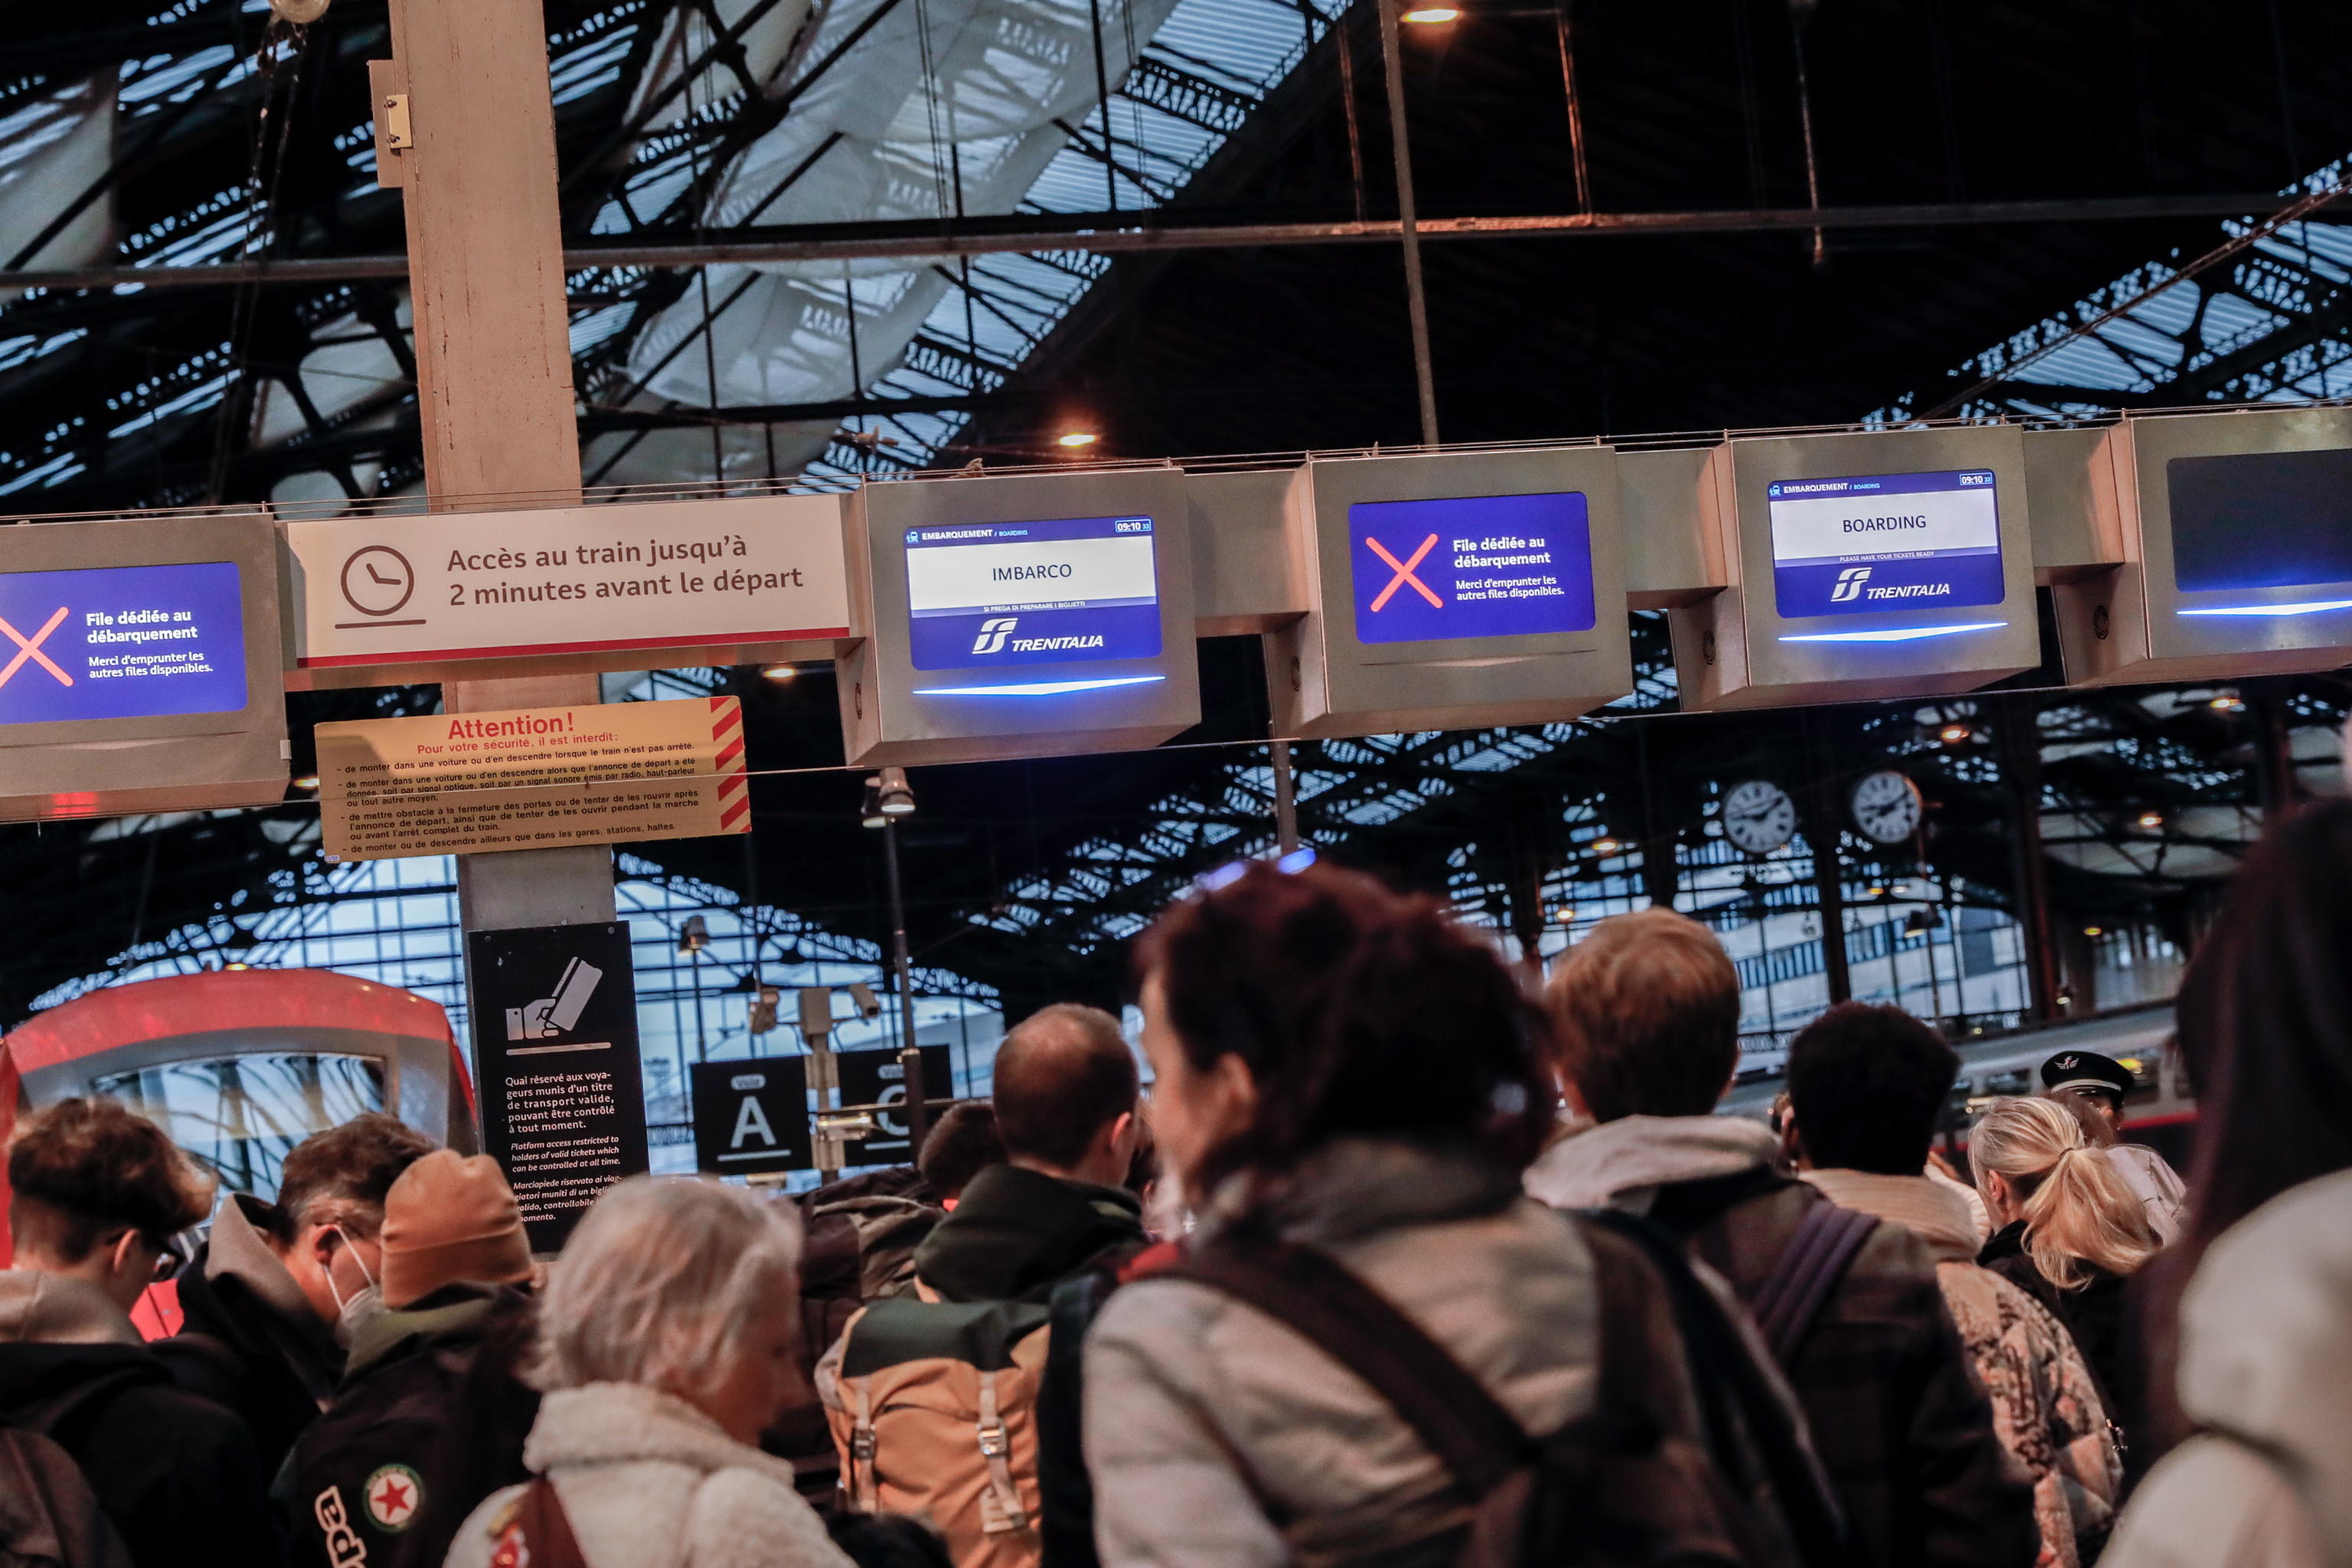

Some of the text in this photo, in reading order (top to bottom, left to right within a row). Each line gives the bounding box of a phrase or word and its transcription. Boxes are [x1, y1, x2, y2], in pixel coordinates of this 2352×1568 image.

[1962, 475, 1983, 484] 09:10
[1784, 483, 1848, 493] EMBARQUEMENT
[1118, 522, 1141, 531] 09:10
[1843, 515, 1926, 533] BOARDING
[922, 530, 992, 540] EMBARQUEMENT
[1454, 537, 1545, 551] File dédiée au
[447, 547, 527, 571] Accès
[536, 549, 567, 567] au
[576, 541, 642, 564] train
[1455, 553, 1551, 568] débarquement
[994, 564, 1072, 581] IMBARCO
[450, 567, 803, 606] 2 minutes avant le départ
[1456, 576, 1557, 590] Merci d'emprunter les
[1867, 583, 1950, 599] TRENITALIA
[1457, 586, 1564, 600] autres files disponibles.
[87, 610, 191, 626] File dédiée au
[87, 627, 198, 644] débarquement
[1012, 635, 1103, 652] TRENITALIA
[89, 652, 204, 666] Merci d'emprunter les
[90, 663, 213, 678] autres files disponibles.
[448, 712, 574, 740] Attention!
[417, 732, 618, 755] Pour votre sécurité, il est interdit:
[345, 765, 356, 773] de
[360, 763, 390, 772] monter
[438, 758, 467, 766] voiture
[485, 755, 503, 763] d'en
[508, 752, 552, 762] descendre
[555, 750, 587, 760] lorsque
[602, 747, 620, 756] train
[624, 745, 645, 754] n'est
[648, 745, 664, 754] pas
[667, 742, 694, 751] arrêté.
[349, 813, 360, 822] de
[364, 812, 392, 820] mettre
[397, 808, 434, 818] obstacle
[446, 806, 454, 815] la
[459, 804, 500, 814] fermeture
[523, 800, 551, 811] portes
[584, 796, 609, 805] tenter
[644, 791, 671, 800] rouvrir
[675, 789, 698, 800] après
[366, 843, 396, 852] monter
[430, 837, 476, 848] descendre
[480, 835, 511, 844] ailleurs
[515, 834, 531, 843] que
[534, 831, 555, 840] dans
[559, 830, 572, 838] les
[576, 829, 603, 839] gares,
[606, 825, 644, 835] stations,
[648, 823, 677, 831] haltes.
[505, 1076, 528, 1088] Quai
[530, 1073, 564, 1084] réservé
[585, 1073, 611, 1082] voya-
[506, 1083, 612, 1100] geurs munis d'un titre
[507, 1094, 614, 1109] de transport valide,
[508, 1105, 615, 1123] pouvant être contrôlé
[730, 1096, 776, 1148] A
[509, 1120, 586, 1134] à tout moment.
[511, 1141, 544, 1151] Platform
[573, 1135, 609, 1146] restricted
[611, 1135, 619, 1143] to
[511, 1146, 619, 1161] holders of valid tickets which
[528, 1163, 537, 1171] be
[539, 1160, 578, 1171] controlled
[580, 1159, 588, 1168] at
[590, 1158, 599, 1167] all
[601, 1158, 621, 1166] time.
[514, 1178, 559, 1190] Marciapiede
[560, 1175, 593, 1186] riservato
[595, 1174, 603, 1183] ai
[541, 1189, 567, 1198] muniti
[544, 1198, 594, 1210] controllabile
